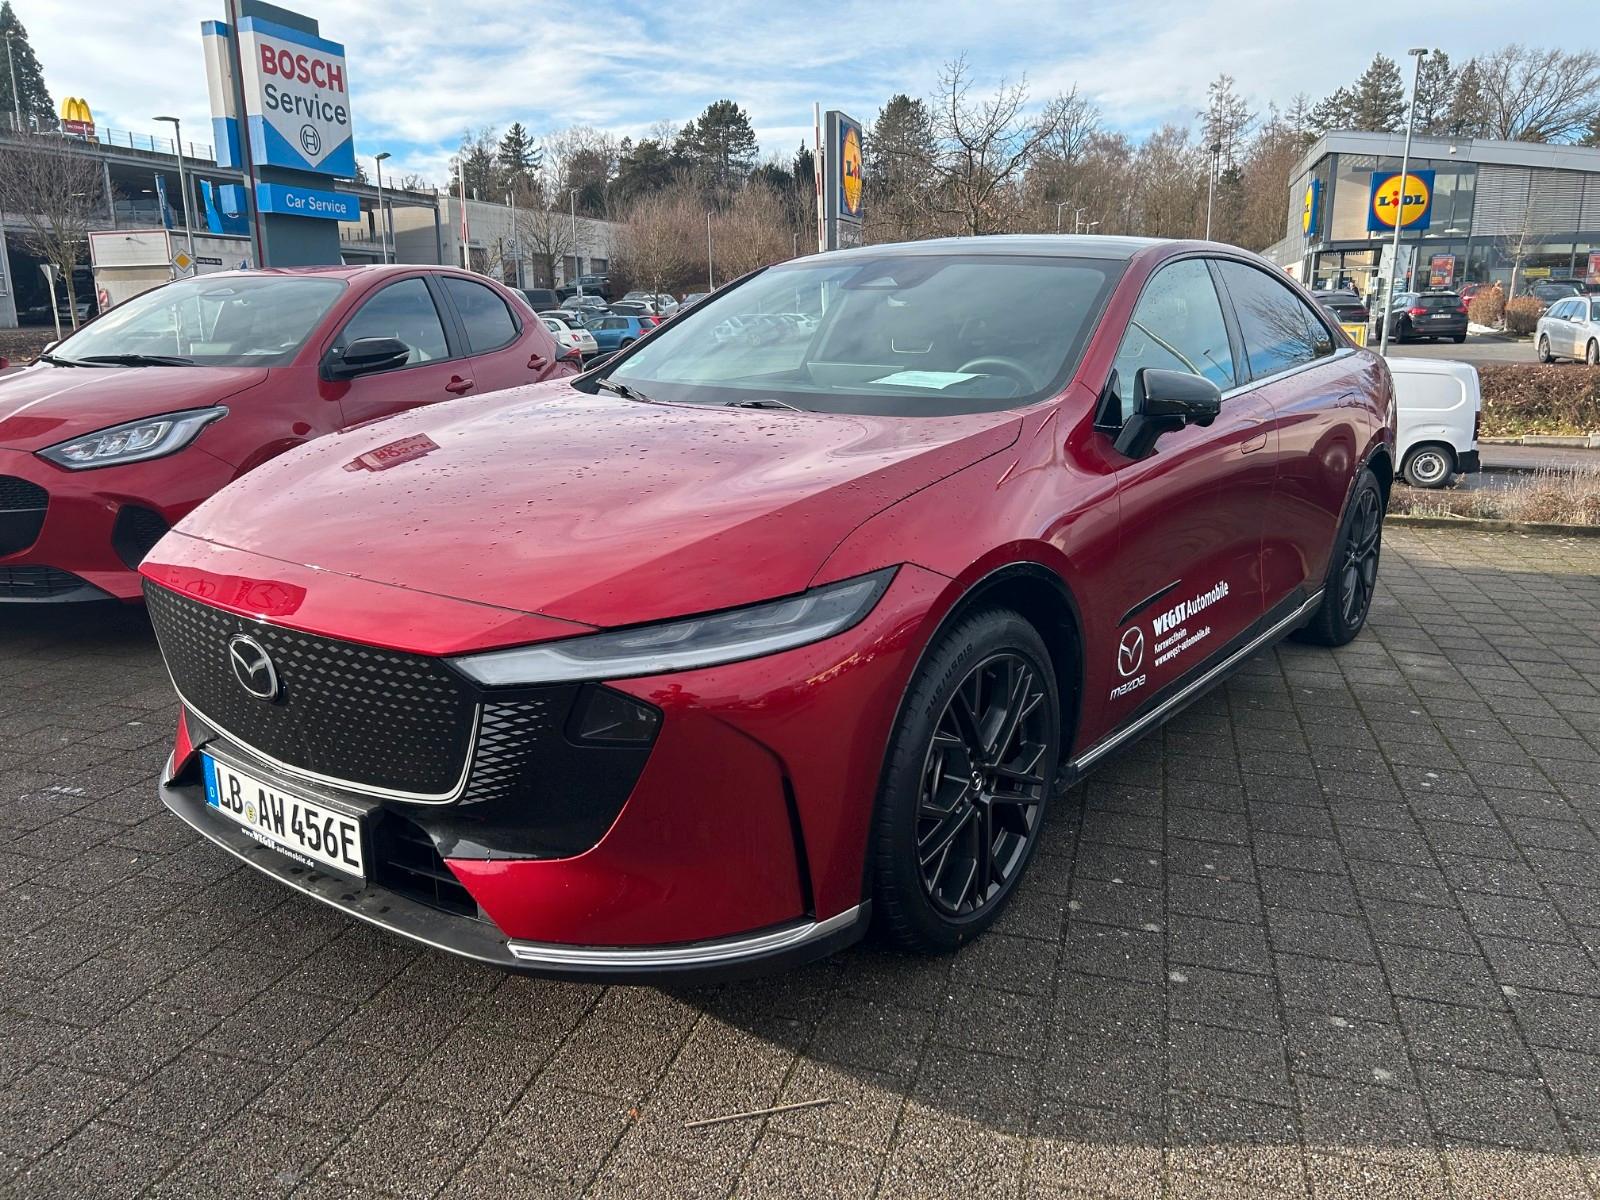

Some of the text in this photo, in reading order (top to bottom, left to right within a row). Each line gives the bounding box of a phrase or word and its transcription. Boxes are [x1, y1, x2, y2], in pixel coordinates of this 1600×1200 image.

[260, 43, 344, 93] BOSCH
[264, 83, 347, 125] Service
[286, 194, 347, 214] Car Service
[1152, 580, 1229, 637] WEGST Automobile
[1110, 674, 1146, 700] mazda
[216, 767, 360, 868] LB AW 456E
